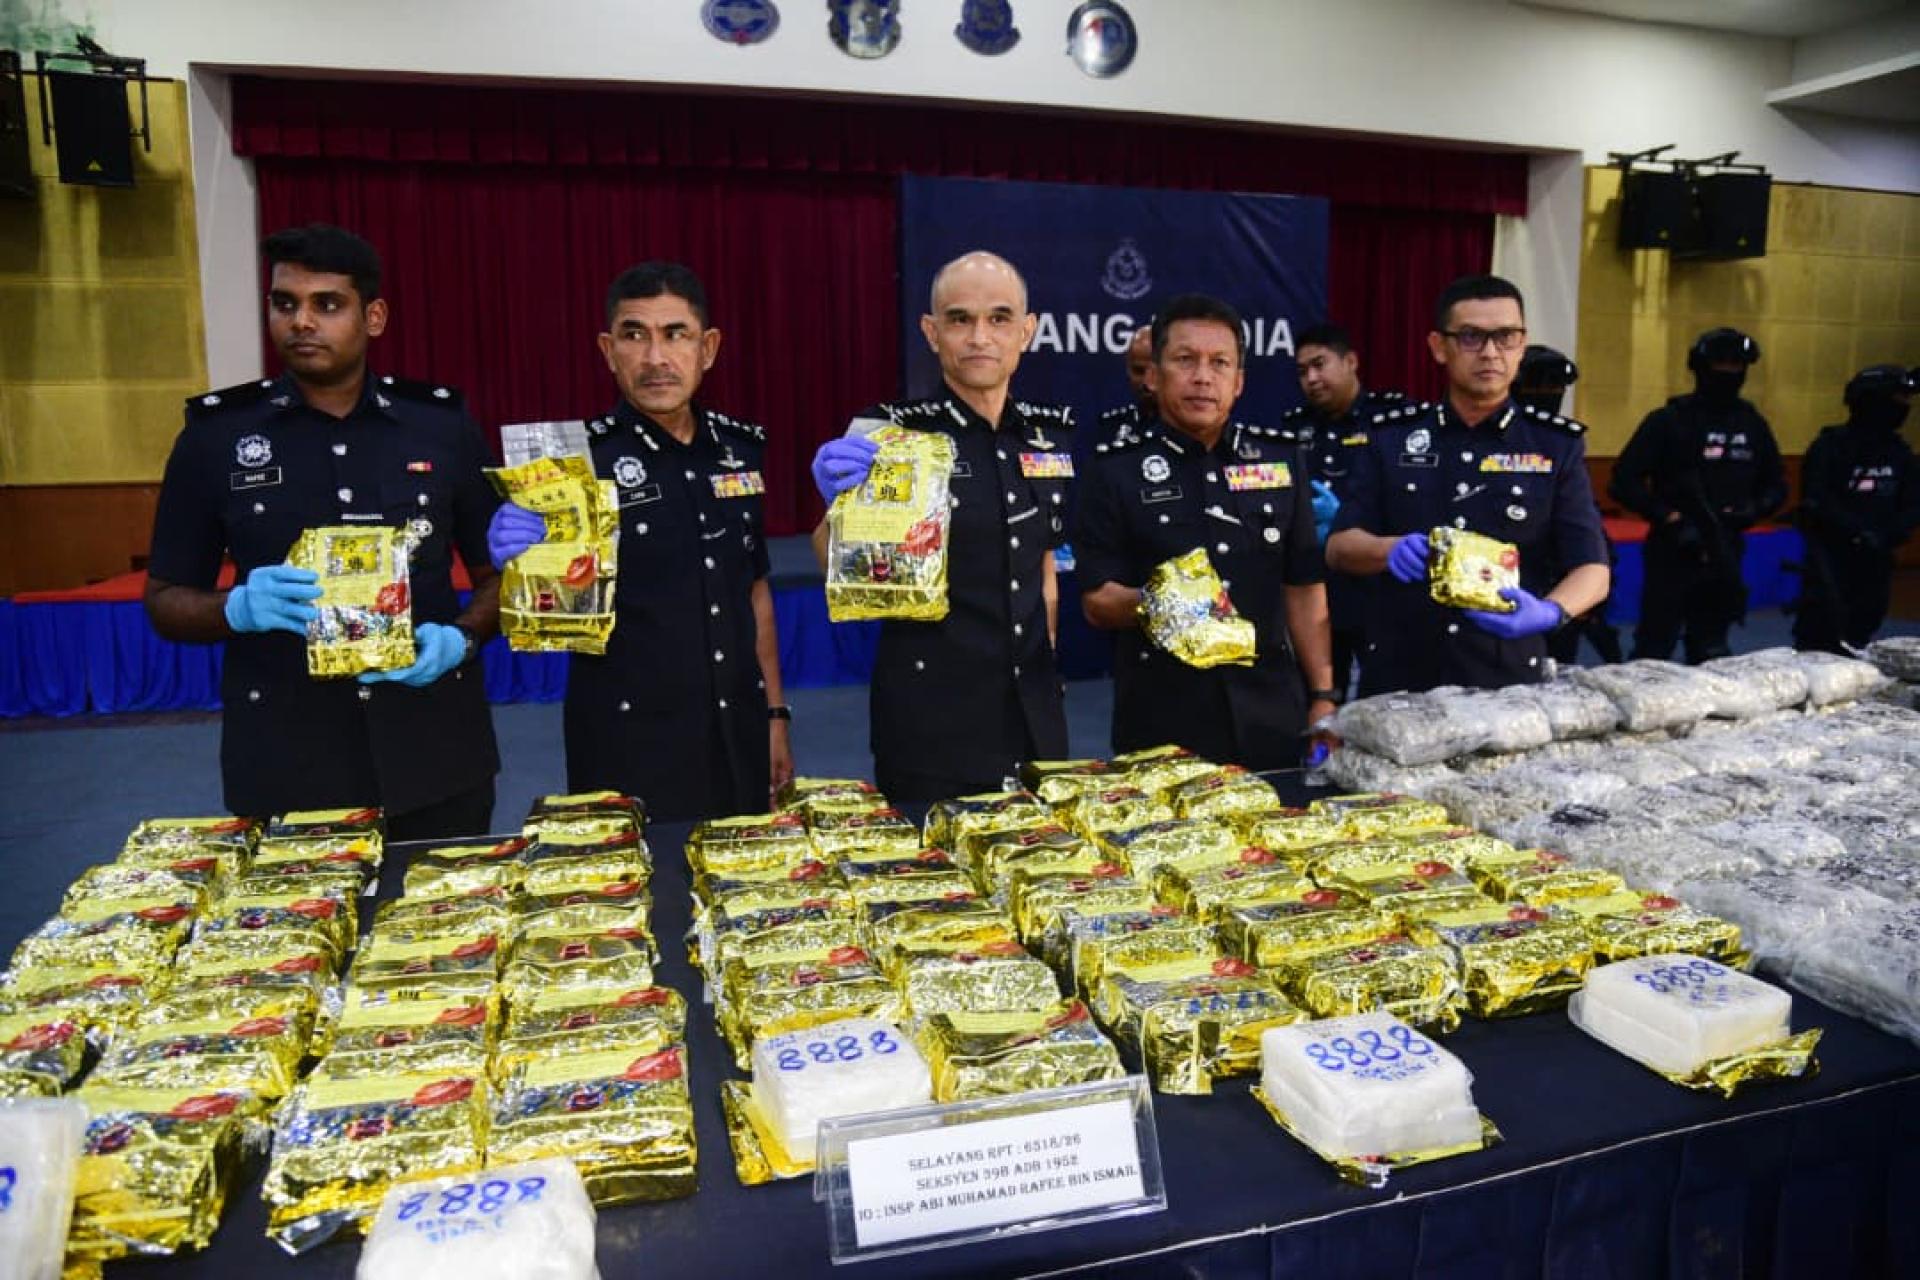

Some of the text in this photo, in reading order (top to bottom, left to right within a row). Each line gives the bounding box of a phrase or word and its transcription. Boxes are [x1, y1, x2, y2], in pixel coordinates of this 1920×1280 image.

[778, 1030, 899, 1071] 8888
[1305, 1025, 1434, 1071] 8888
[909, 1150, 984, 1171] SELAYANG
[987, 1144, 1013, 1160] RPT
[916, 1168, 979, 1190] SEKSYEN
[983, 1165, 1009, 1181] 39B
[1047, 1154, 1079, 1170] 1952
[884, 1201, 915, 1217] INSP
[919, 1198, 944, 1212] ABI
[947, 1185, 1016, 1206] MUHAMAD
[1069, 1172, 1090, 1186] BIN
[1093, 1165, 1138, 1181] ISMAIL
